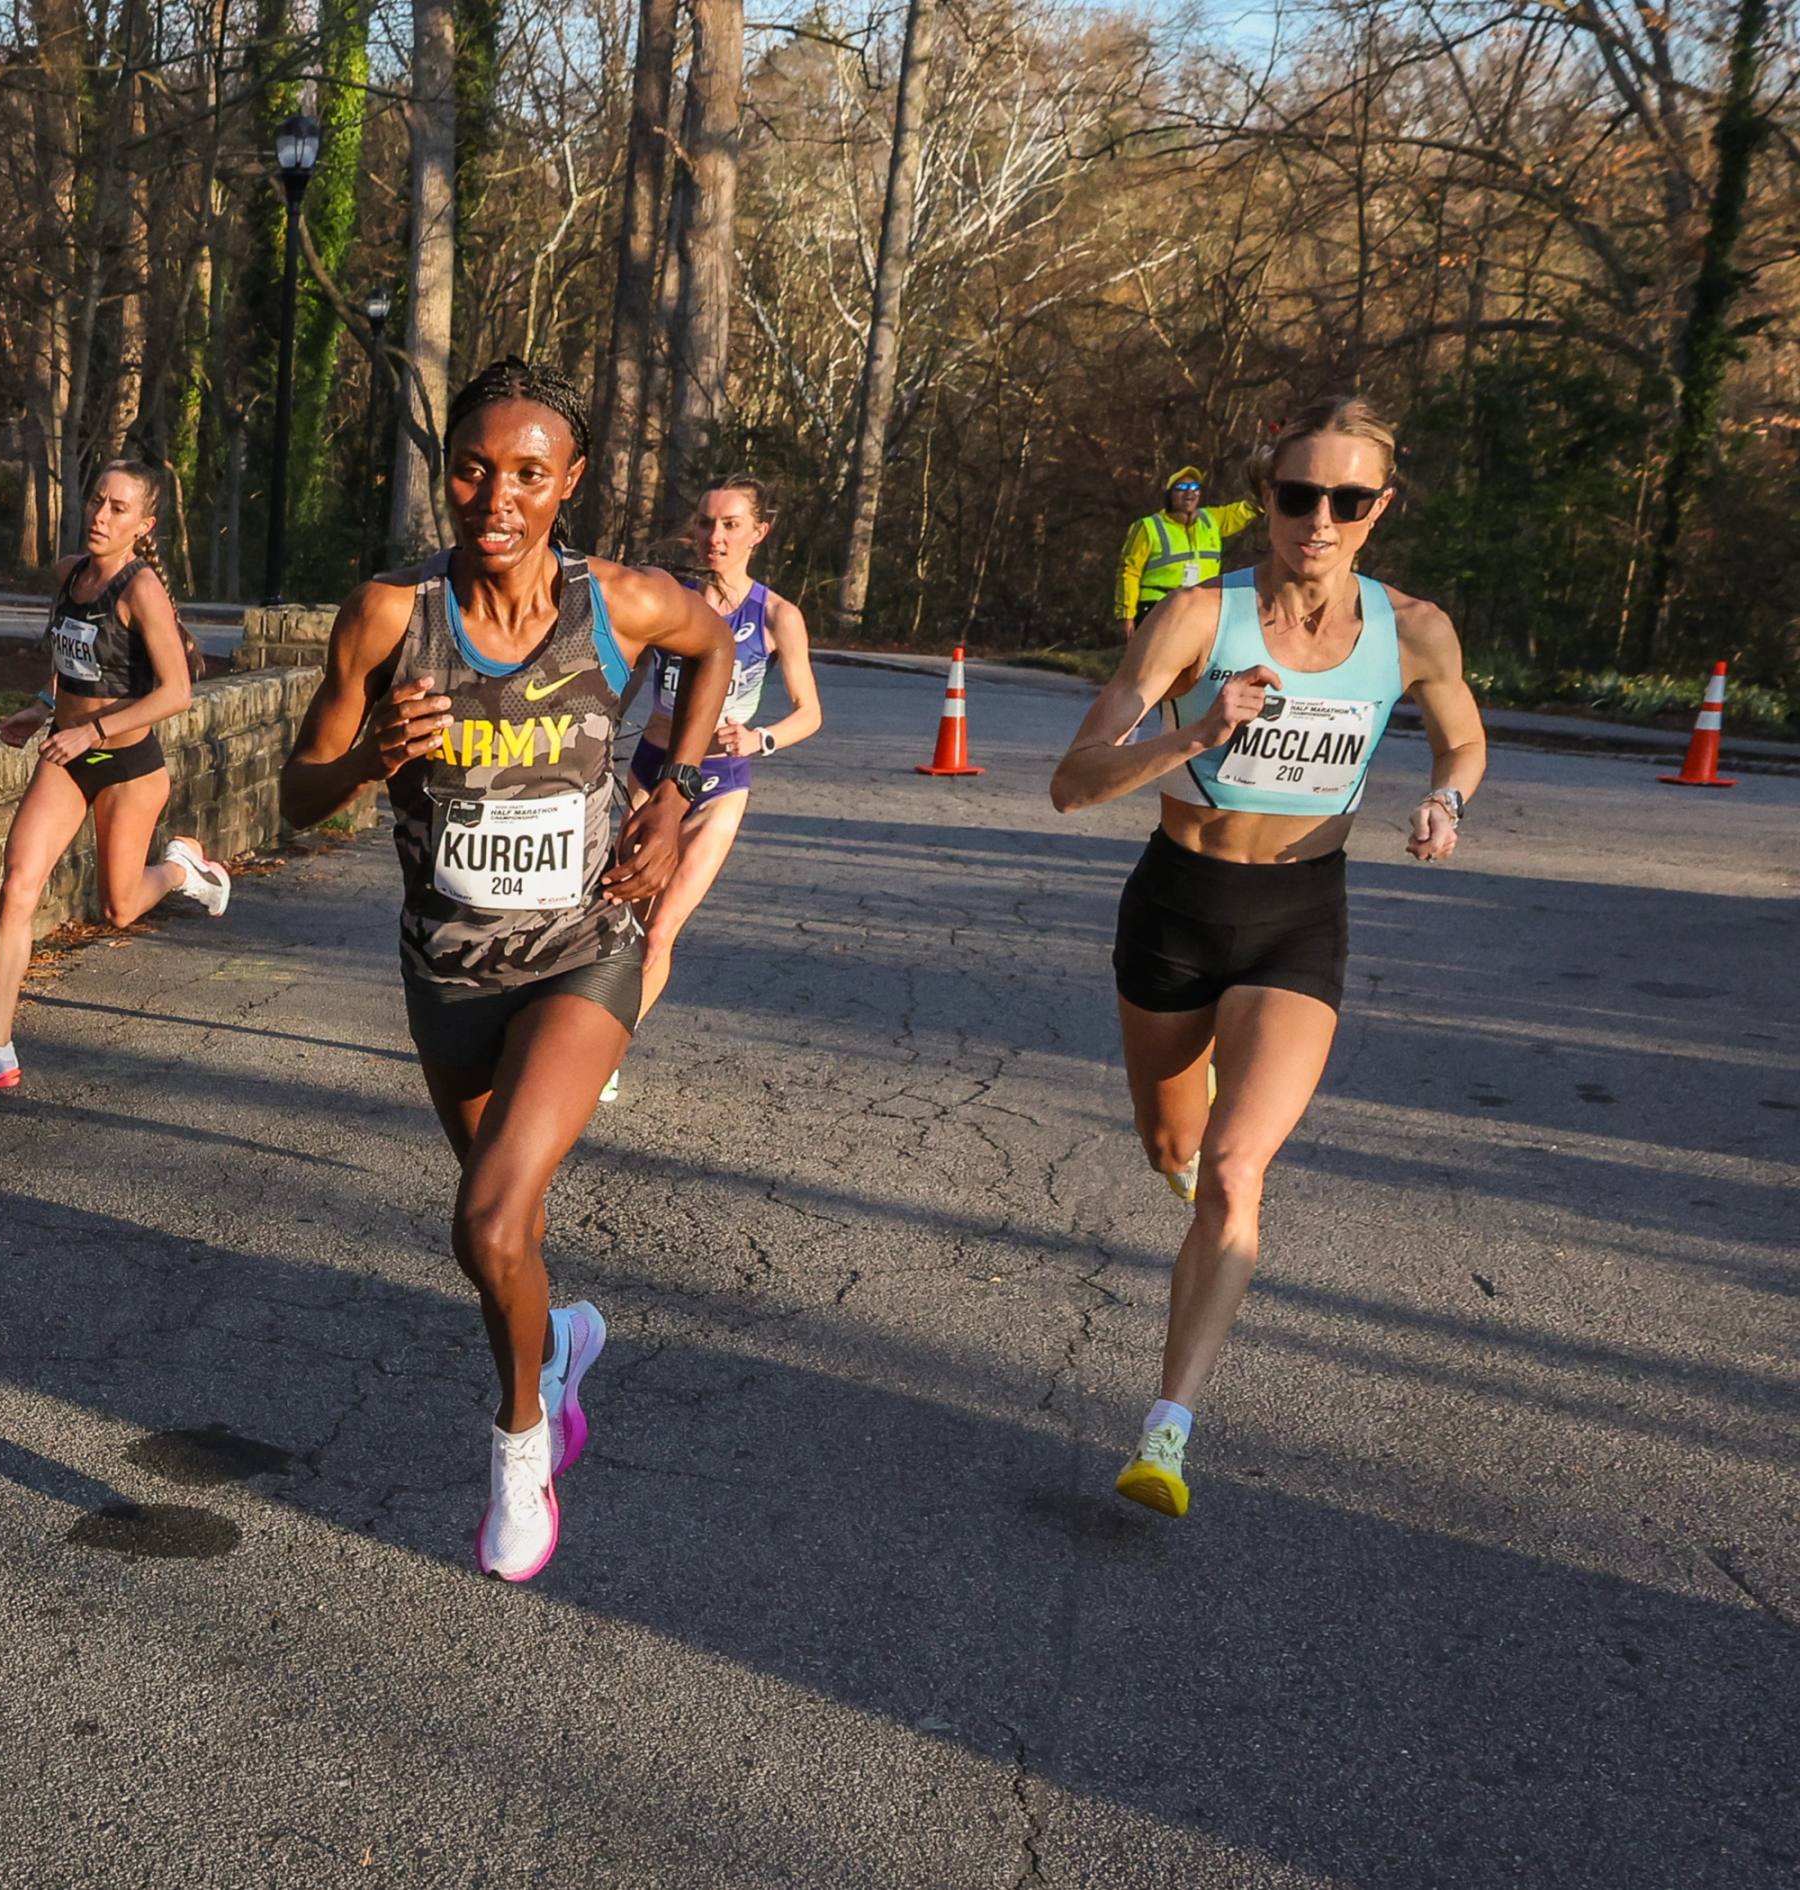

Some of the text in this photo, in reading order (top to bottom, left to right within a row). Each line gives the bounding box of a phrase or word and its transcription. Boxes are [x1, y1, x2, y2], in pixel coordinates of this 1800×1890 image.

[51, 631, 92, 662] PARKER
[426, 714, 573, 767] ARMY
[1233, 726, 1365, 765] MCCLAIN
[1275, 765, 1304, 782] 210
[513, 807, 559, 815] MARATHON
[444, 829, 574, 872] KURGAT
[491, 877, 523, 895] 204
